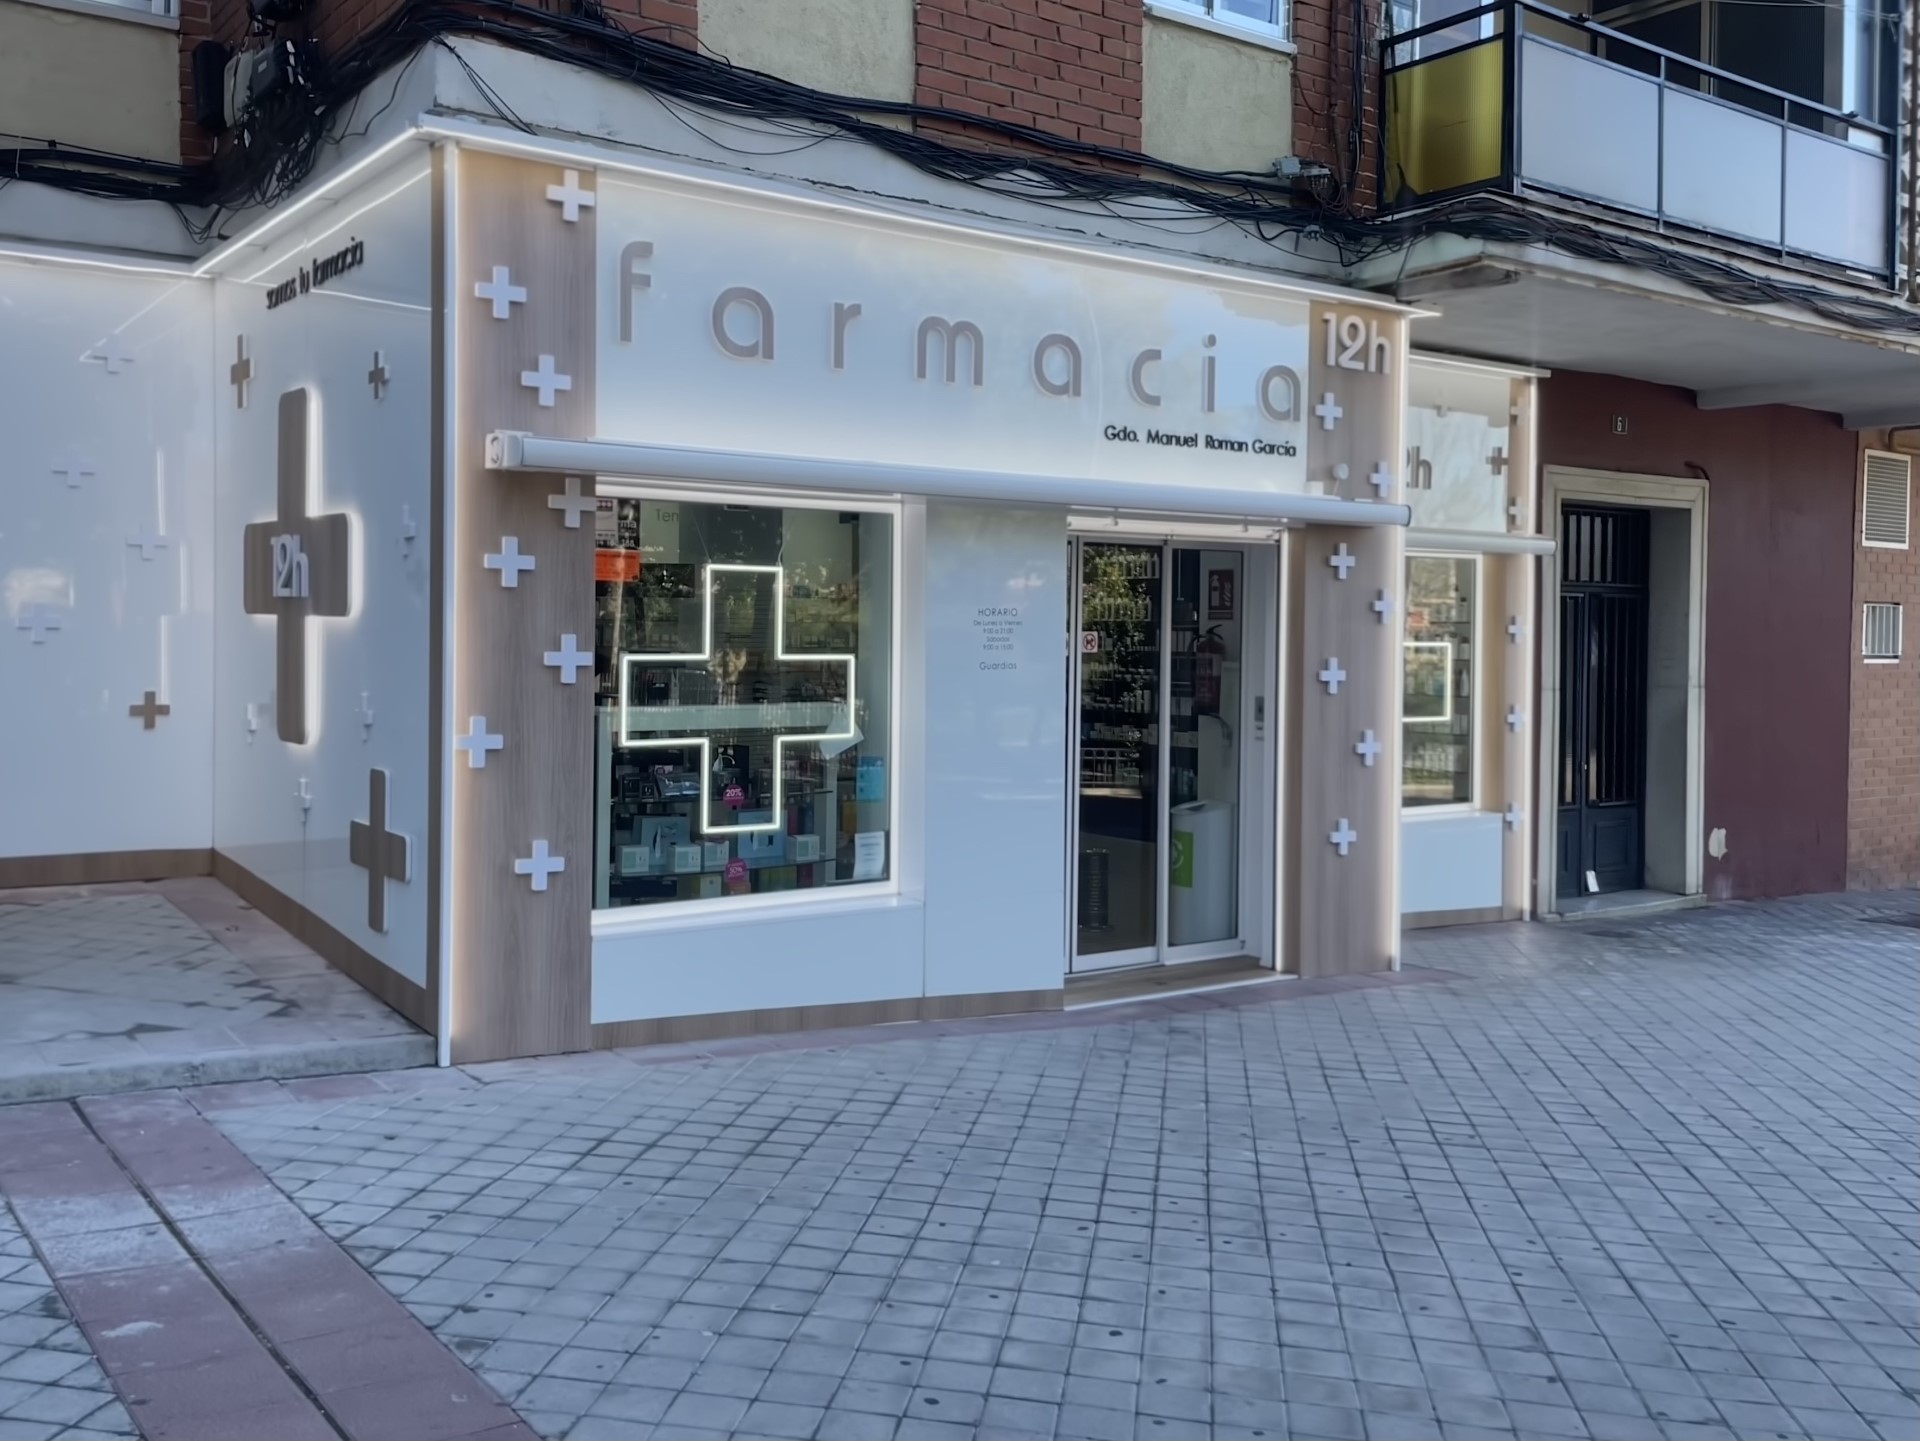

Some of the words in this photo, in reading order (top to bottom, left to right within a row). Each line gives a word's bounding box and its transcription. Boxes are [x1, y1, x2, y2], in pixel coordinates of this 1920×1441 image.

[312, 236, 364, 287] farmacia
[619, 240, 1302, 423] farmacia
[1322, 311, 1391, 375] 12h
[1104, 425, 1140, 443] Gdo.
[1146, 429, 1198, 448] Manuel
[1204, 434, 1249, 453] Roman
[1616, 416, 1623, 432] 6
[270, 534, 310, 598] 12h
[977, 607, 1018, 617] HORARIO
[978, 661, 1017, 670] Guardias
